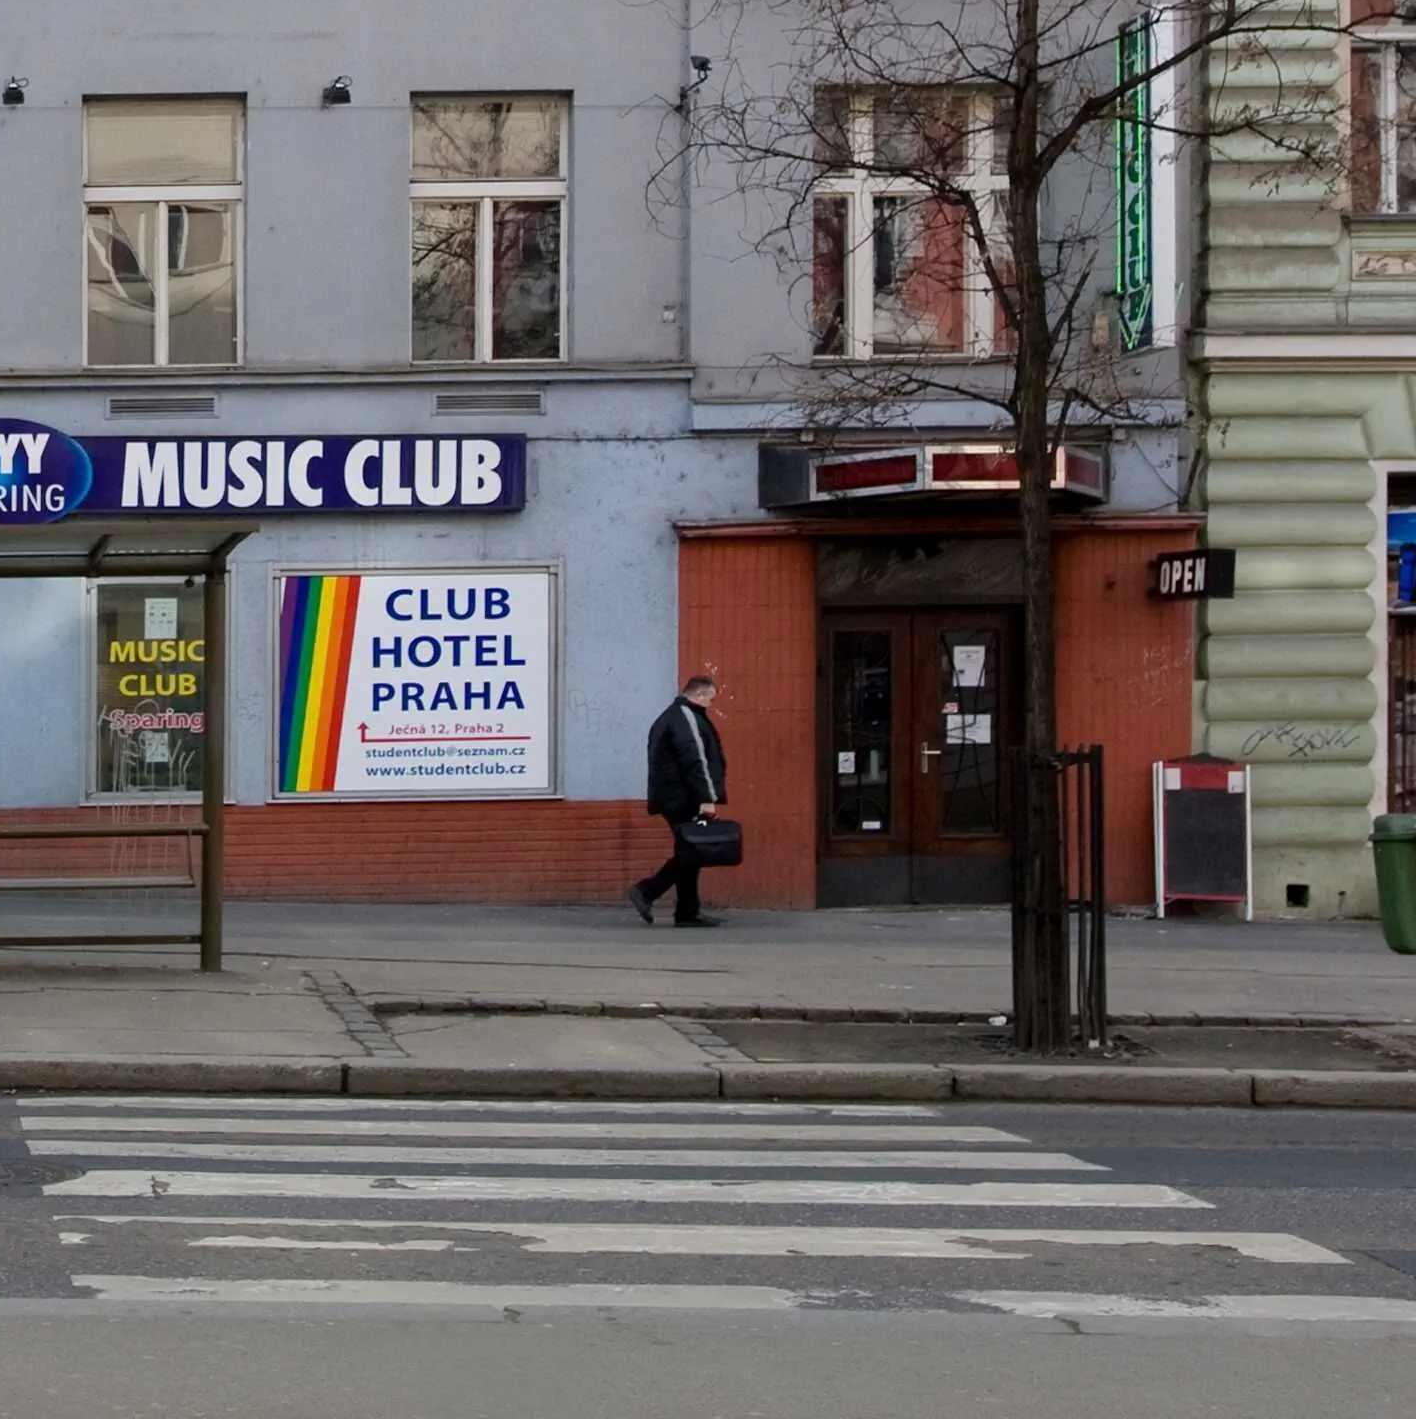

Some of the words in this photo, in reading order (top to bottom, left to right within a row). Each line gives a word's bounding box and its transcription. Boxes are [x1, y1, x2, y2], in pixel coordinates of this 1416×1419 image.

[121, 439, 324, 508] MUSIC
[344, 439, 502, 507] CLUB
[1159, 557, 1206, 594] OPEN
[385, 587, 511, 621] CLUB
[109, 639, 205, 663] MUSIC
[372, 635, 526, 668] HOTEL
[119, 673, 197, 697] CLUB
[371, 681, 525, 712] PRAHA
[109, 707, 205, 734] Sparing
[388, 722, 426, 736] Ječná
[431, 724, 449, 735] 12,
[454, 723, 493, 734] Praha
[496, 724, 505, 734] 2
[365, 745, 526, 759] studentclub@seznam.cz
[365, 762, 526, 777] www.studentclub.cz
